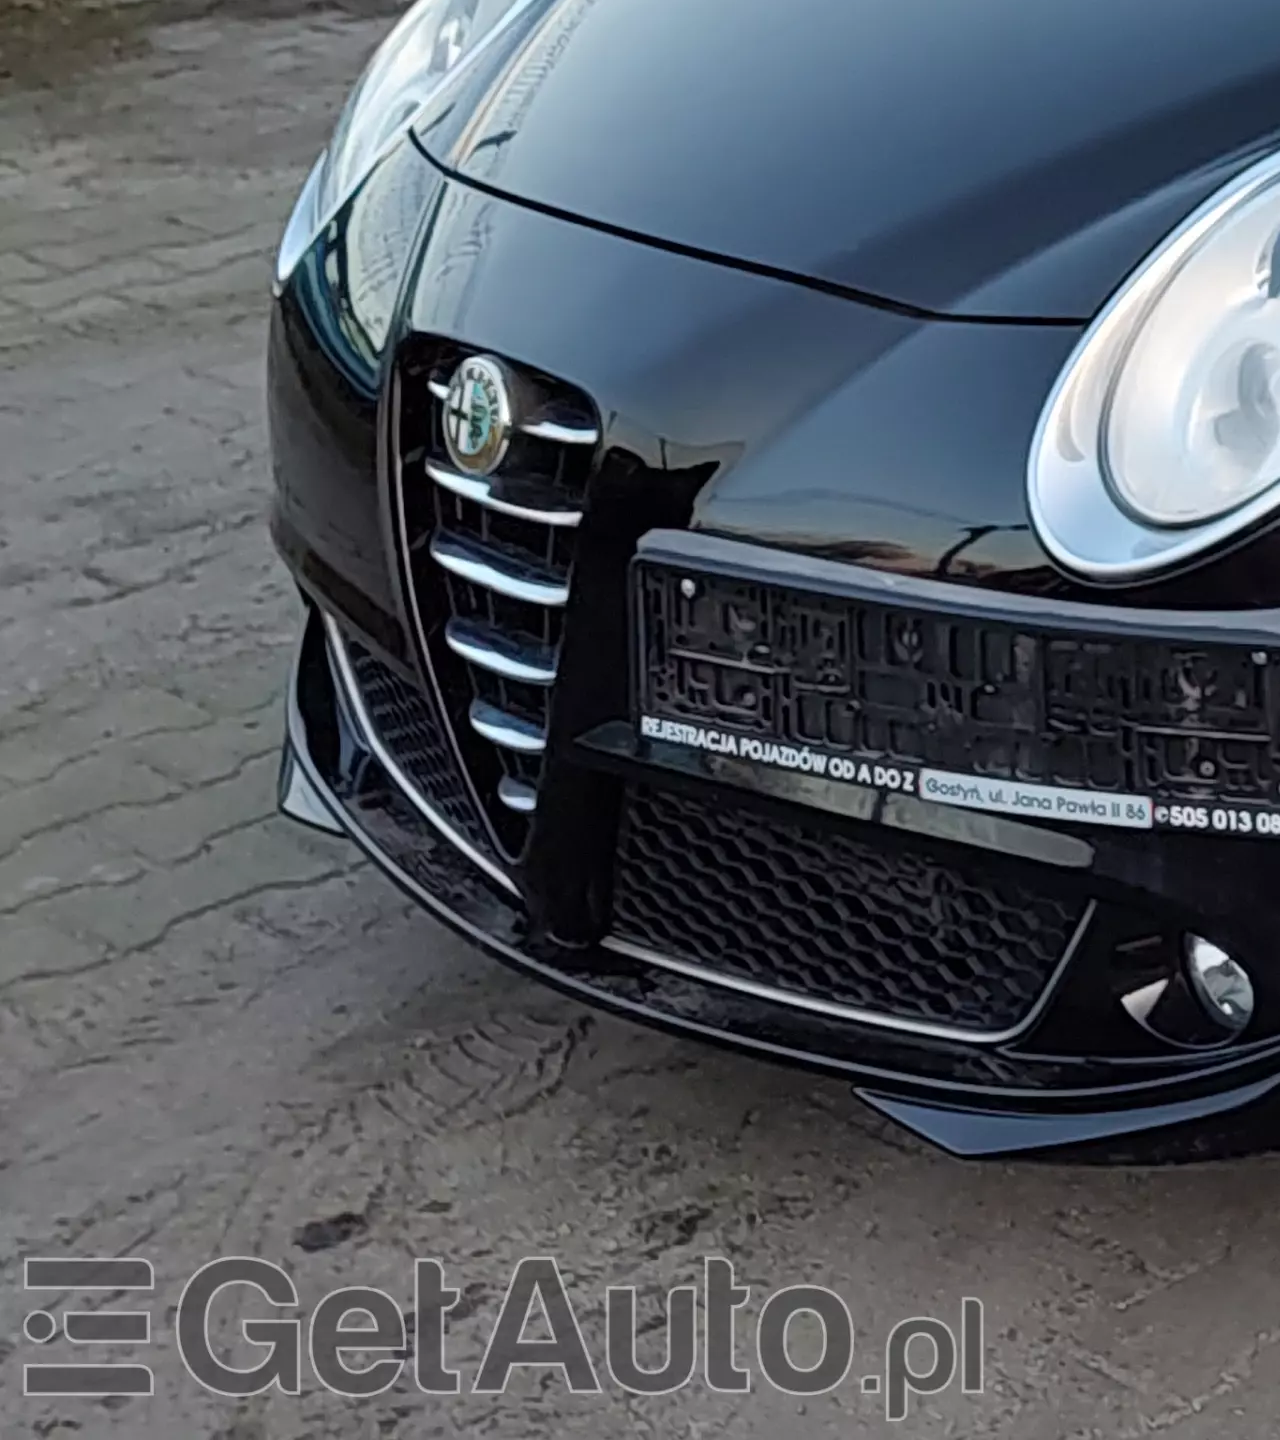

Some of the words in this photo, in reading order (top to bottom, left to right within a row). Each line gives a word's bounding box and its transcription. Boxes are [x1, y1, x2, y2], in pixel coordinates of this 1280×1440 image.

[641, 715, 737, 754] REJESTRACJA
[740, 738, 827, 774] POJAZDÓW
[829, 758, 853, 779] OD
[857, 764, 871, 785] A
[874, 766, 901, 788] DO
[903, 771, 915, 792] Z
[988, 788, 1005, 805] ul.
[1011, 791, 1052, 811] Jana
[1057, 796, 1106, 817] Pawła
[1111, 800, 1121, 818] II
[1125, 802, 1147, 821] 86
[1170, 806, 1207, 828] 505
[1212, 809, 1252, 832] 013
